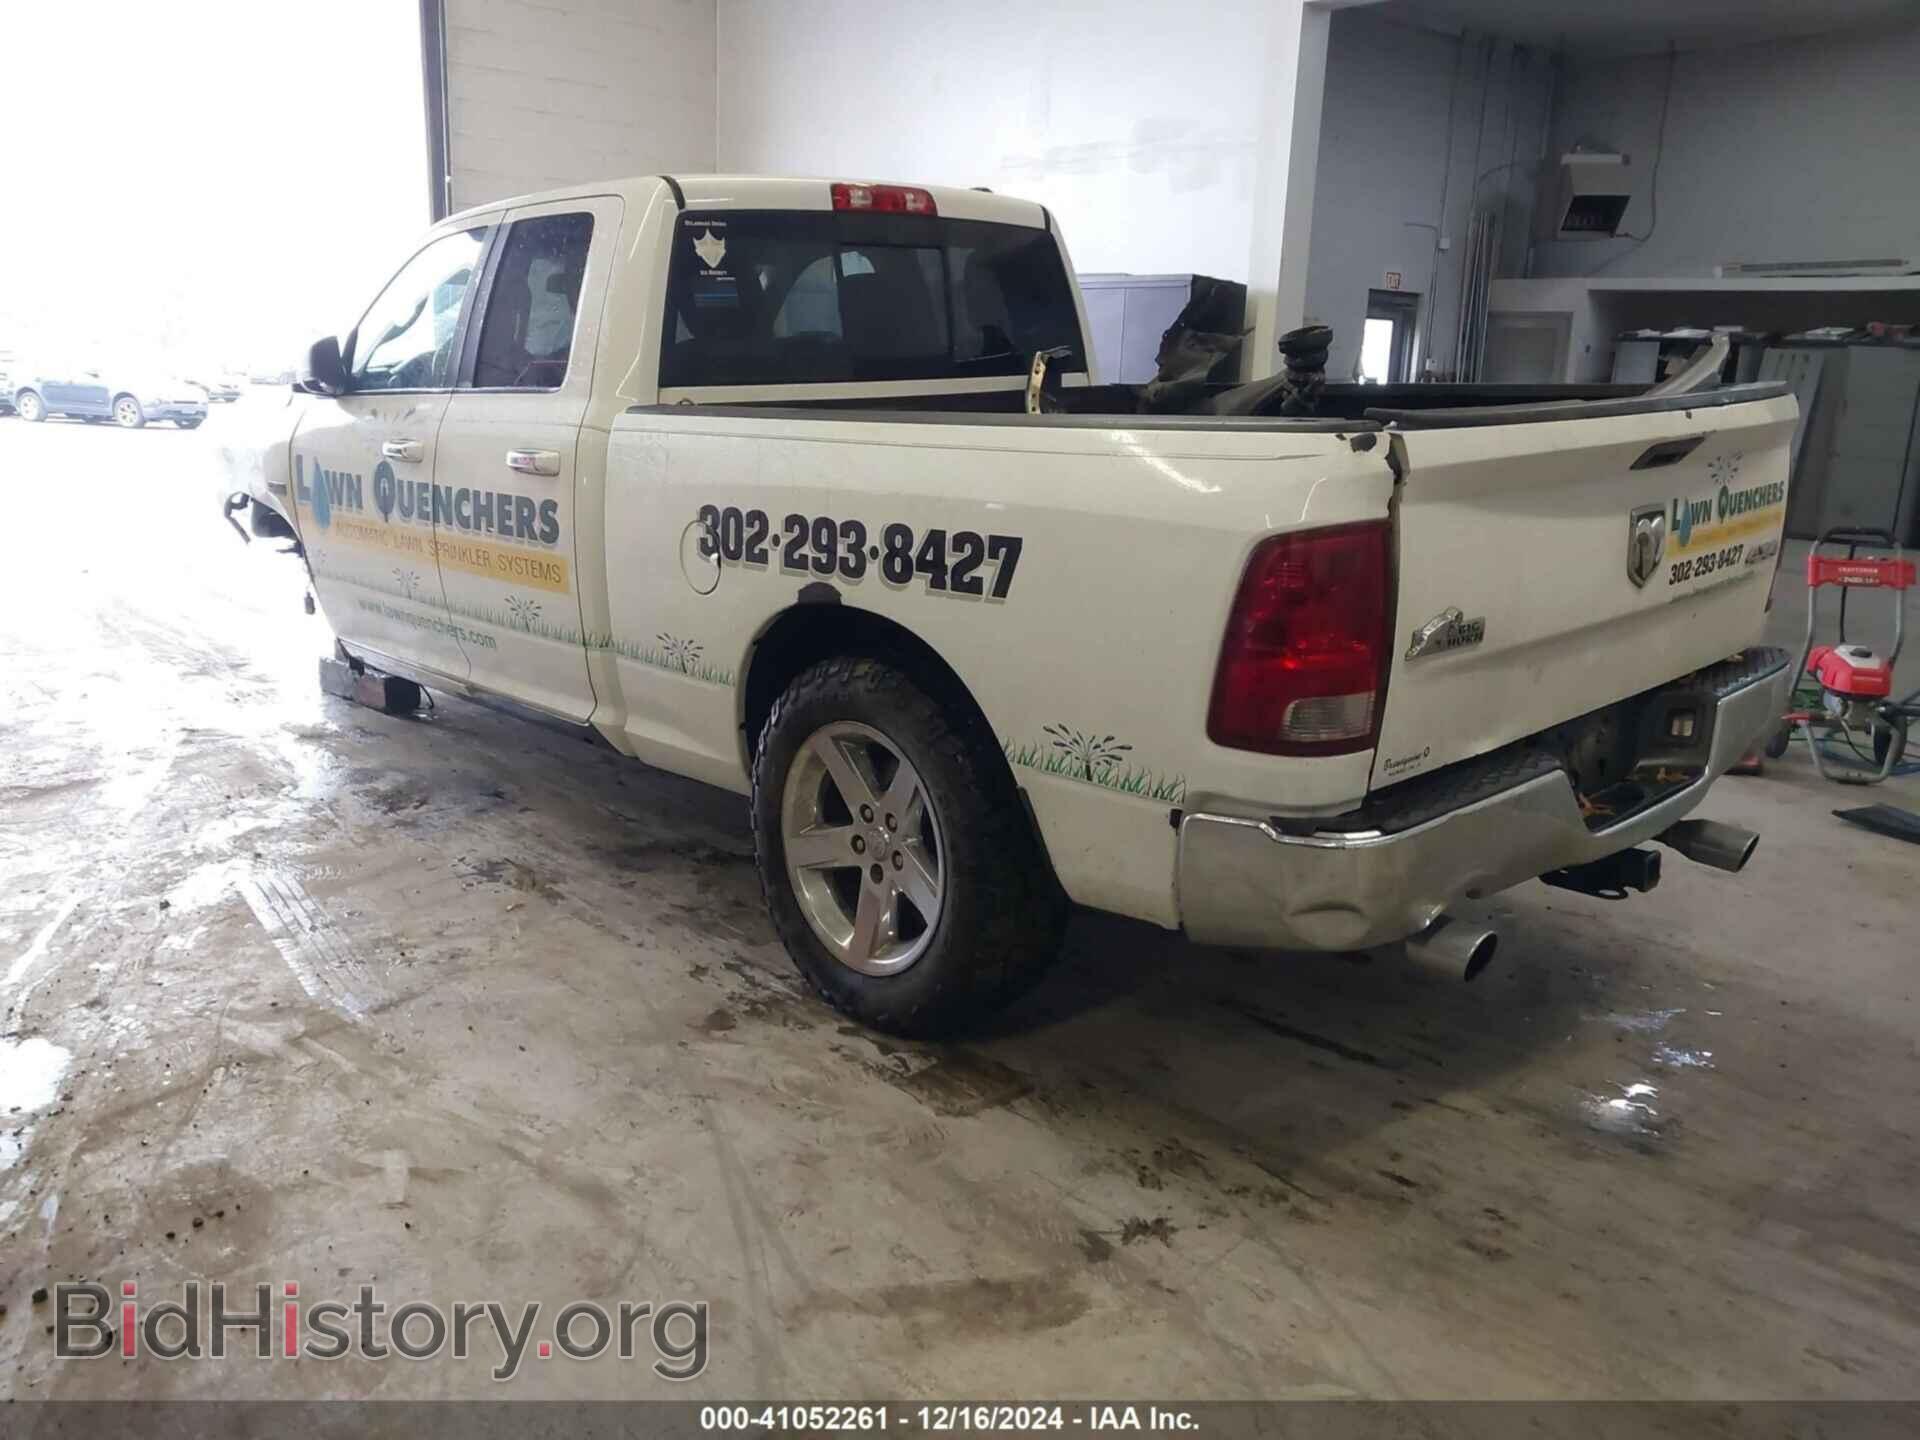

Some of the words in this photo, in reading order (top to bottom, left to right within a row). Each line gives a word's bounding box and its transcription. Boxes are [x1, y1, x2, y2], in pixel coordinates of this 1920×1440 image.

[374, 460, 560, 545] QUENCHERS
[1718, 483, 1784, 524] QUENCHERS
[428, 537, 492, 569] SPRINKLER
[498, 552, 561, 584] SYSTEMS
